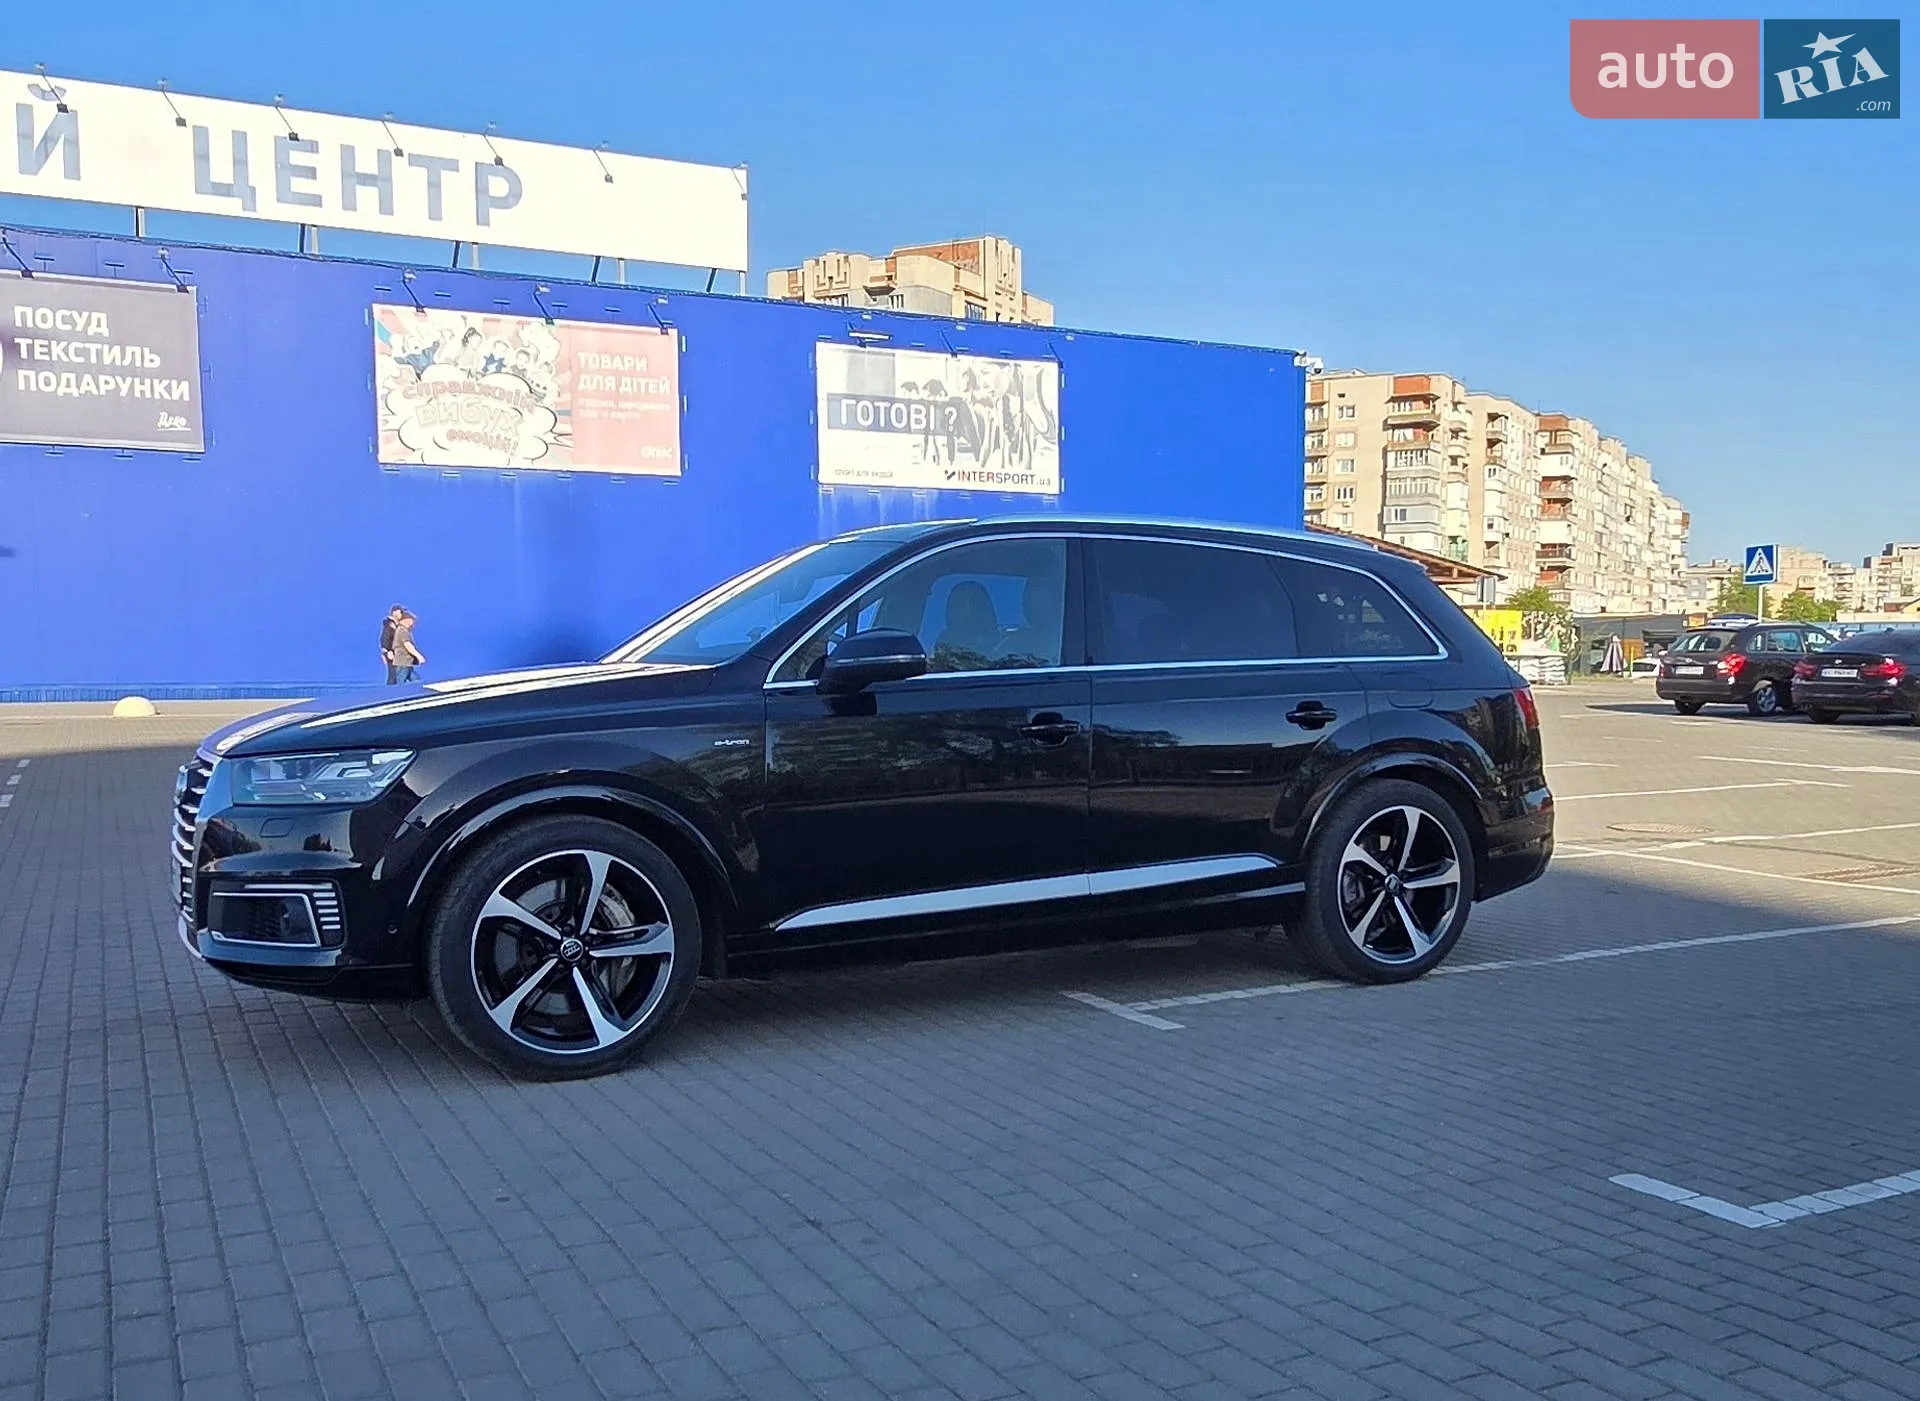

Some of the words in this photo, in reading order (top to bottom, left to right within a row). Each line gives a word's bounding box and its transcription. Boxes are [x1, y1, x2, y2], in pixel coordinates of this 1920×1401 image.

[192, 124, 523, 228] ЦЕНТР
[14, 305, 109, 337] ПОСУД
[14, 337, 161, 369] ТЕКСТИЛЬ
[577, 352, 648, 372] ТОВАРИ
[17, 369, 190, 401] ПОДАРУНКИ
[577, 373, 617, 391] ДЛЯ
[619, 375, 671, 395] ДІТЕЙ
[840, 399, 935, 430] ГОТОВІ
